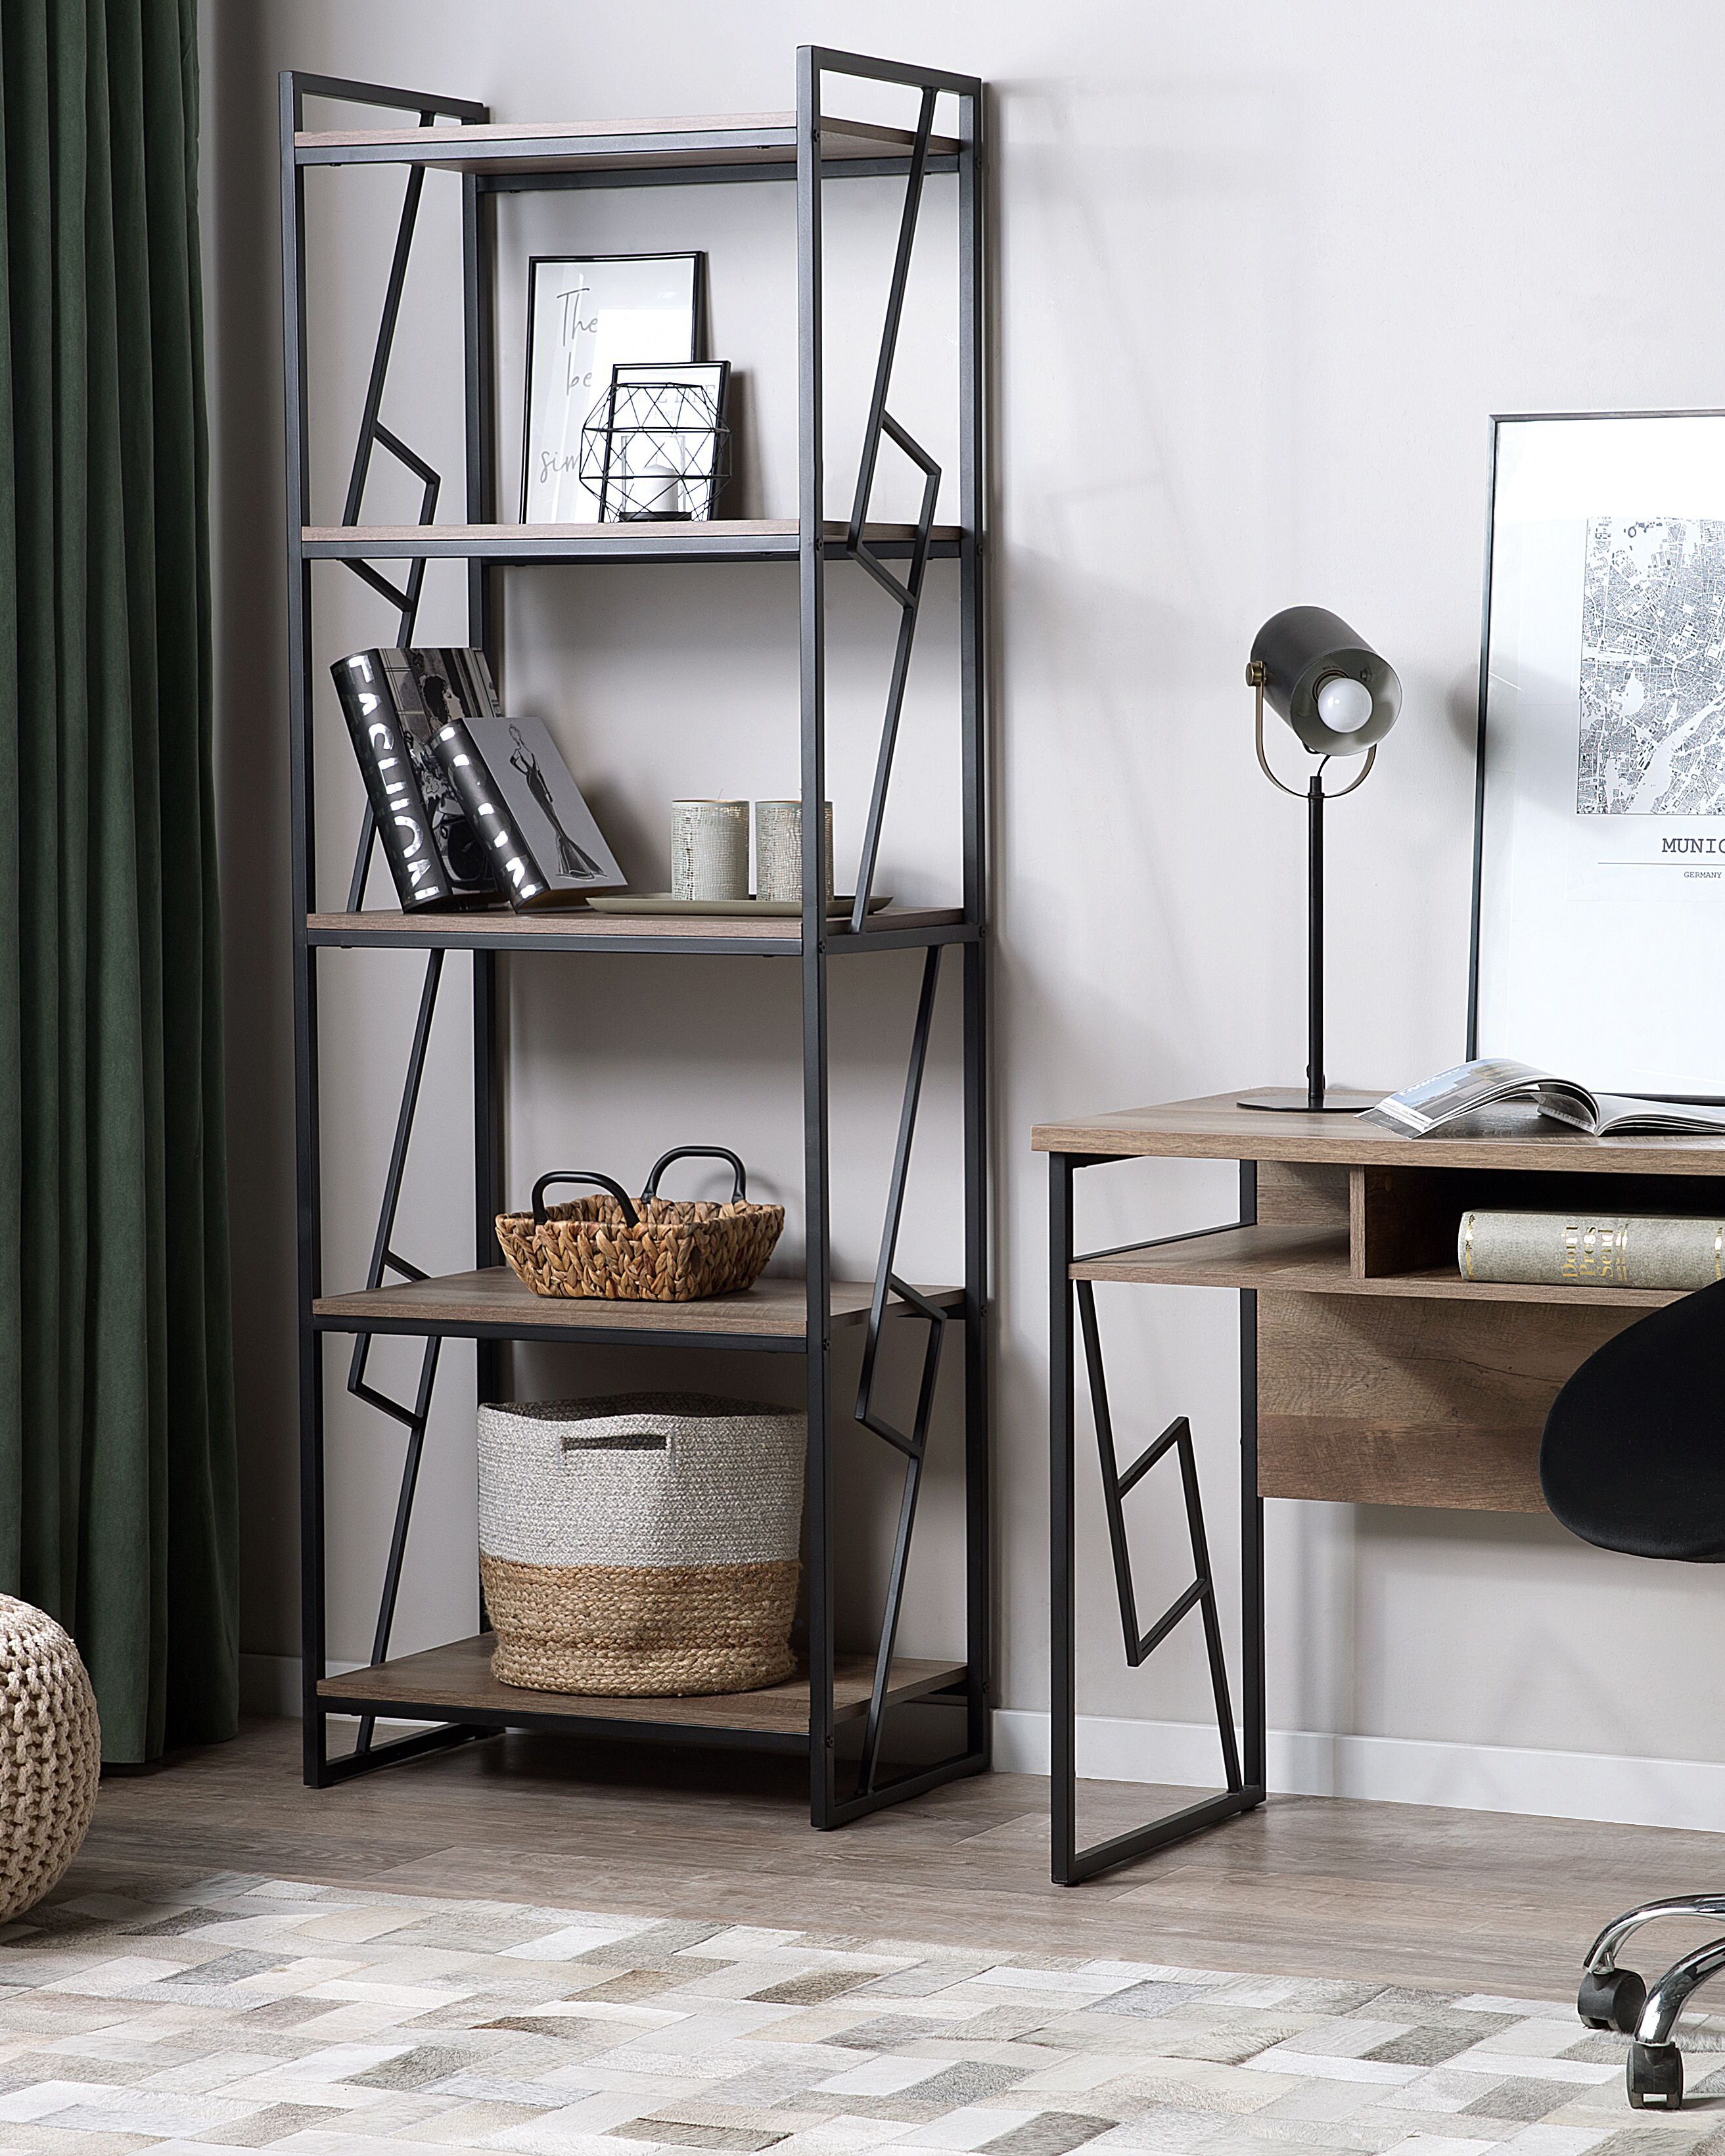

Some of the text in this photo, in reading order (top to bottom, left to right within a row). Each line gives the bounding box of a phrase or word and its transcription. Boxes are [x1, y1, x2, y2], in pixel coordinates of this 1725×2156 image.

[556, 287, 598, 348] The
[566, 352, 591, 396] be
[342, 654, 440, 902] FASHION
[1562, 1226, 1579, 1277] Don't
[1578, 1226, 1596, 1275] Press
[1598, 1229, 1614, 1277] Send
